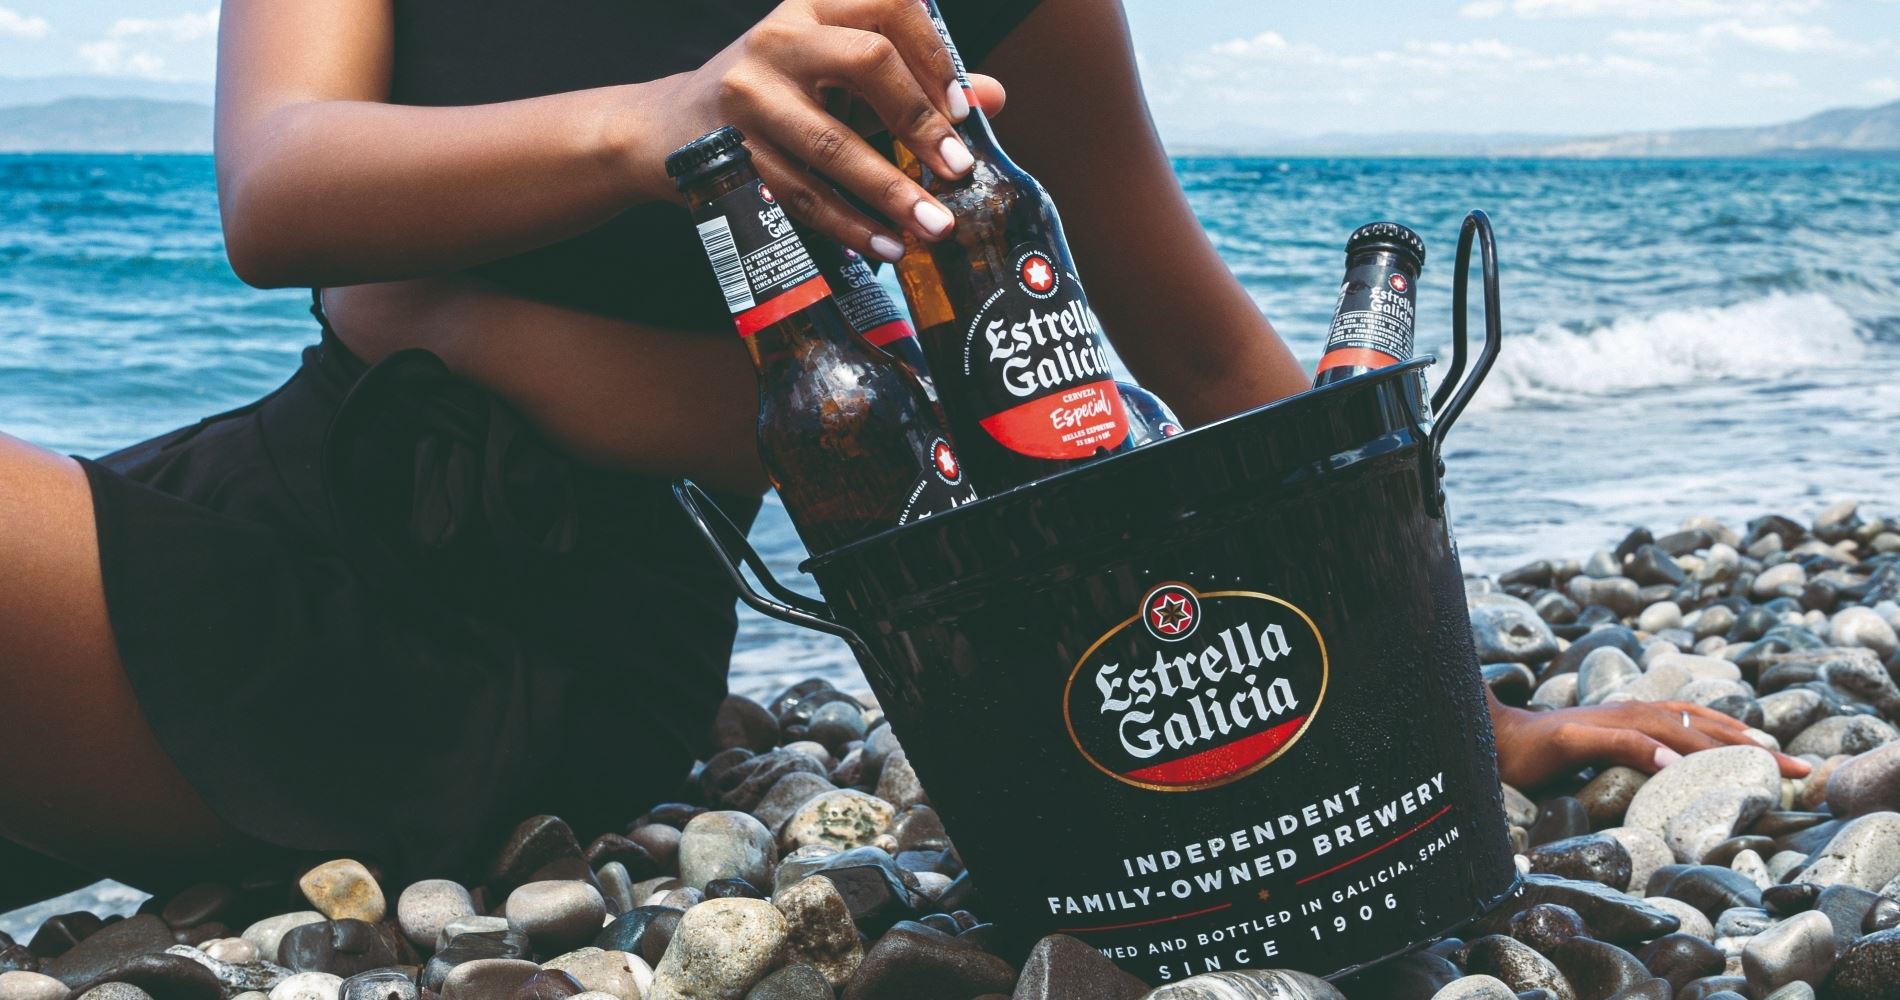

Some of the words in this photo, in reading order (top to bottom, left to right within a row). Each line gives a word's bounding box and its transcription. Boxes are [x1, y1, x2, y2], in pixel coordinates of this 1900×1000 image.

[754, 278, 772, 290] CINCO
[756, 256, 772, 267] ESTA
[1360, 316, 1385, 326] CERVEZA
[1370, 286, 1414, 318] Estrella
[1371, 298, 1412, 328] Galicia
[1002, 338, 1111, 397] Galicia
[1050, 388, 1112, 430] Especial
[1062, 388, 1096, 403] CERVEZA
[899, 510, 909, 526] VEXA
[909, 480, 928, 504] CERVEJA
[1096, 622, 1292, 714] Estrella
[1119, 674, 1298, 759] Galicia
[1048, 848, 1298, 915] FAMILY-OWNED
[1312, 772, 1446, 857] BREWERY
[1124, 784, 1362, 878] INDEPENDENT
[1098, 945, 1138, 959] WED
[1148, 938, 1188, 956] AND
[1198, 910, 1292, 947] BOTTLED
[1302, 898, 1323, 917] IN
[1332, 862, 1415, 904] GALICIA,
[1418, 827, 1460, 862] SPAIN
[1159, 940, 1280, 980] SINCE
[1311, 893, 1398, 942] 1906
